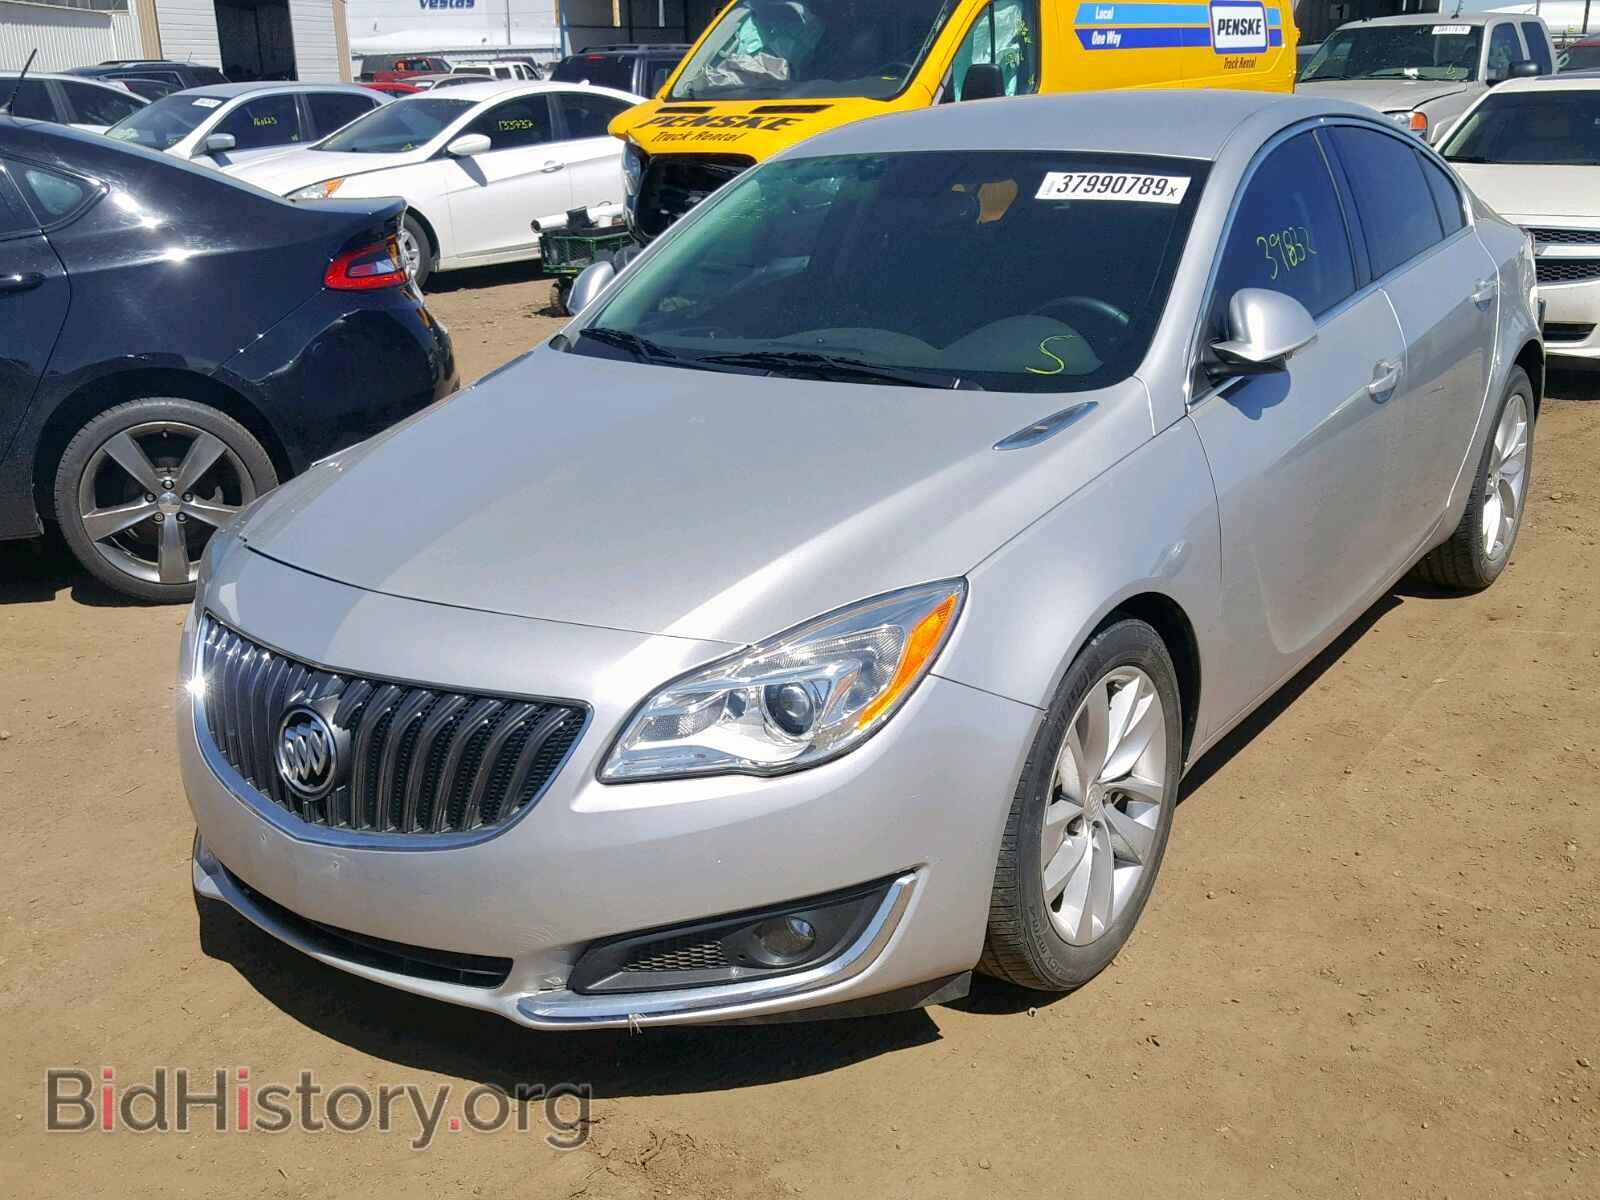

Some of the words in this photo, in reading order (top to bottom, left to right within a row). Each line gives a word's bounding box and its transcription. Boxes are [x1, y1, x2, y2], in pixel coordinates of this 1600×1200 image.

[1095, 5, 1114, 20] Local
[1217, 17, 1262, 36] PENSKE
[1091, 30, 1106, 45] One
[1106, 30, 1121, 48] Way
[1224, 56, 1240, 70] Truck
[1239, 56, 1256, 69] Rental
[634, 115, 804, 131] PENSKE
[651, 131, 689, 142] Truck
[692, 131, 749, 142] Rental
